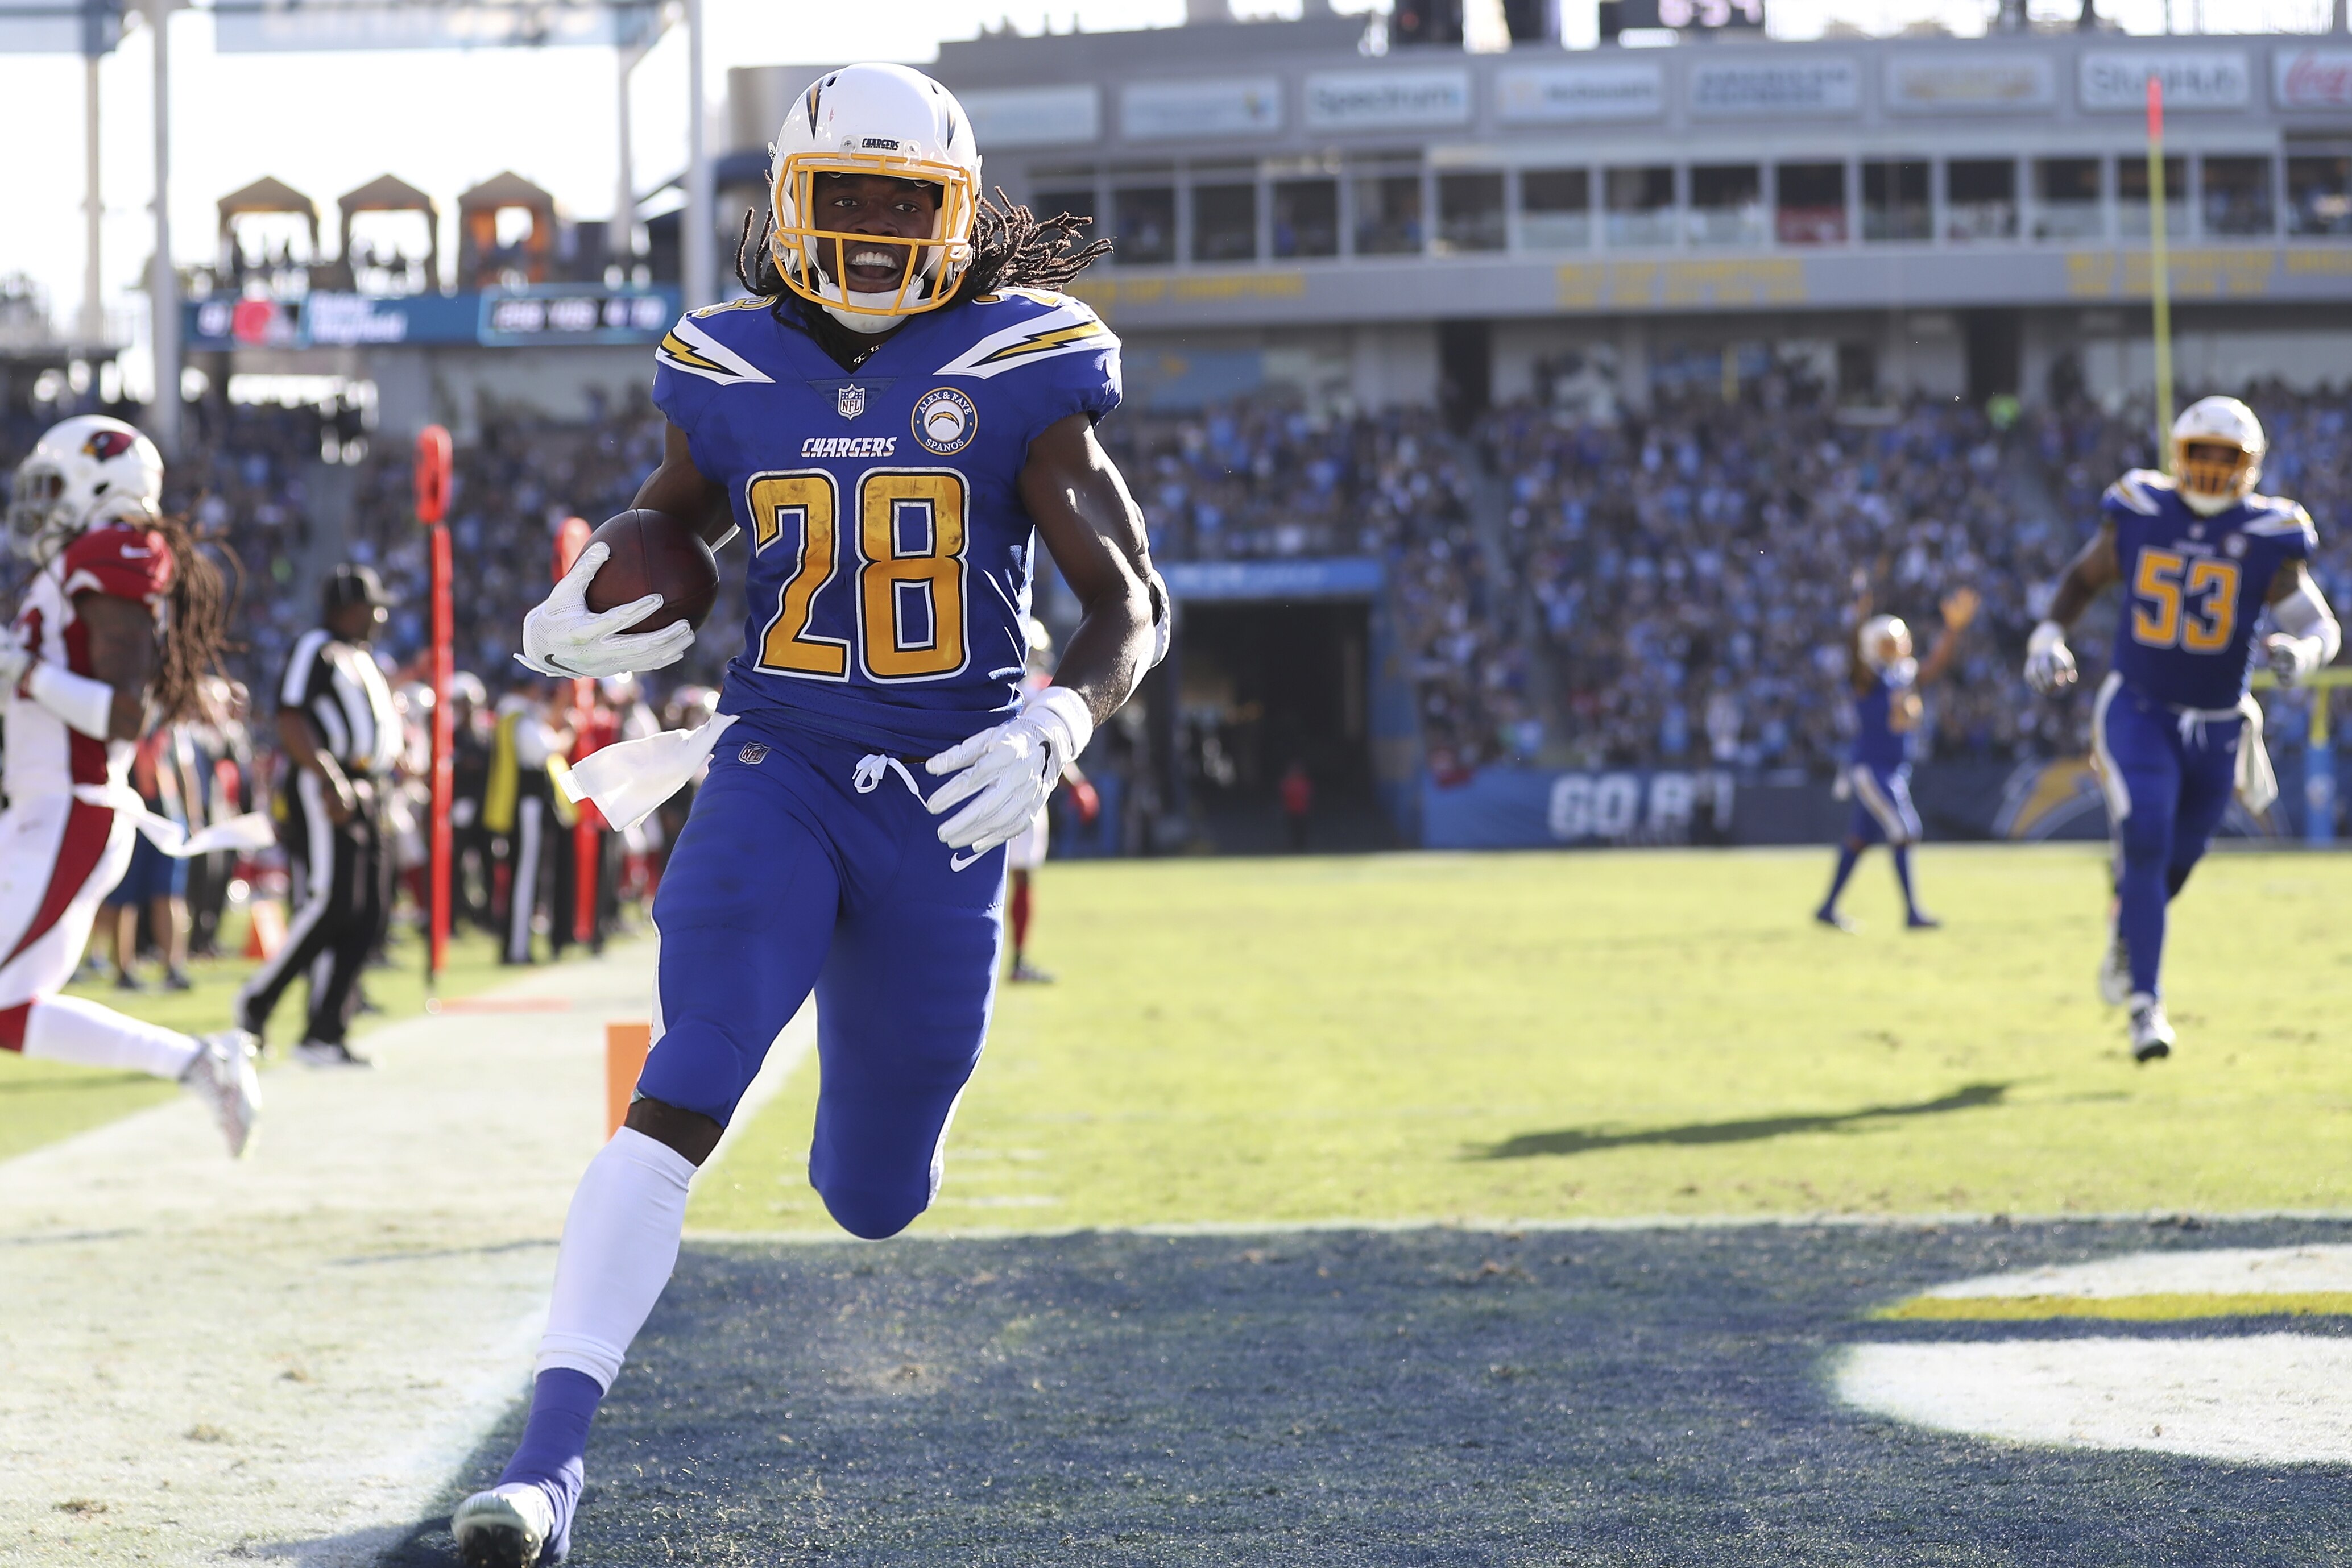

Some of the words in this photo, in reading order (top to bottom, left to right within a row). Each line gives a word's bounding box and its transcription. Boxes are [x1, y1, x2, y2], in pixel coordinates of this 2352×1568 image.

[862, 138, 900, 151] CHARGERS
[842, 400, 860, 413] NFL
[918, 392, 942, 414] ALEX
[951, 393, 972, 415] FAYE
[801, 437, 897, 457] CHARGERS
[925, 438, 964, 451] SPANOS
[745, 467, 970, 684] 28
[2131, 544, 2243, 654] 53
[742, 749, 760, 761] NFL
[1549, 771, 1639, 840] GO
